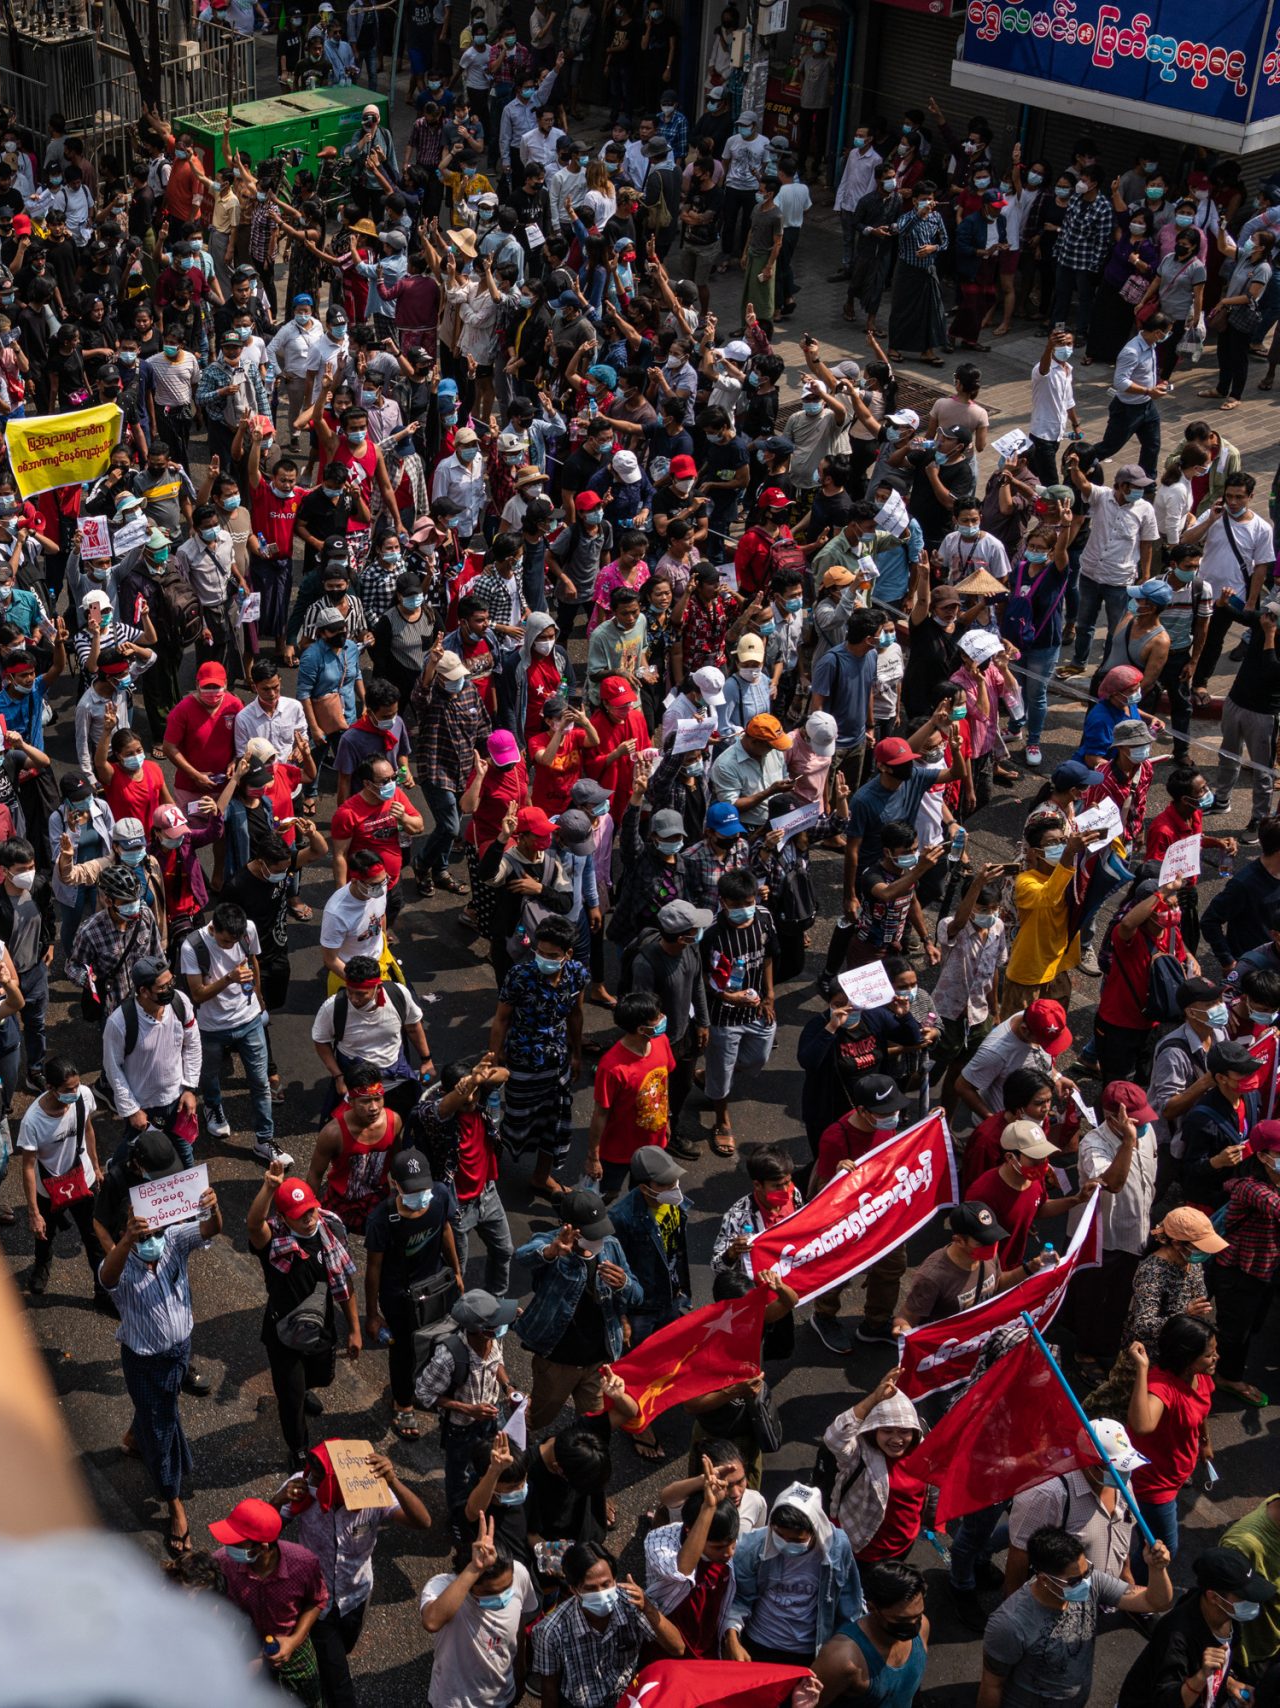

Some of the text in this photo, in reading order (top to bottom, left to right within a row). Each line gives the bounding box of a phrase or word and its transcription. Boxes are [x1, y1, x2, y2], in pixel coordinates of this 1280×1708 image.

[138, 1171, 199, 1200] ပြည်သူချစ်သော
[151, 1190, 184, 1208] အမေစု
[406, 1227, 433, 1247] NIKE
